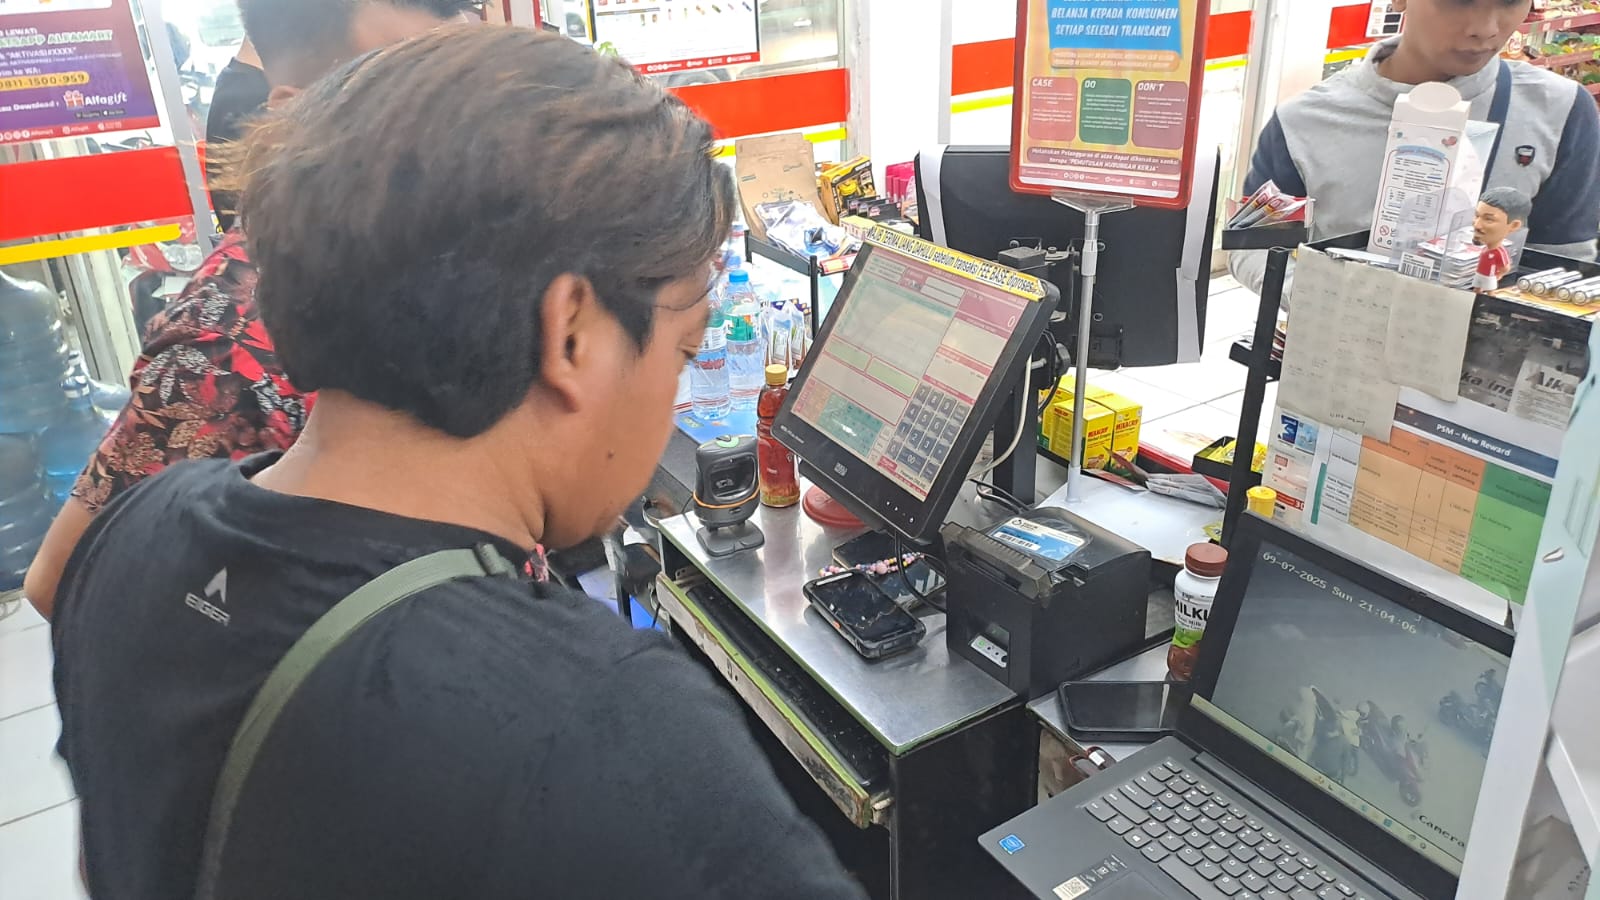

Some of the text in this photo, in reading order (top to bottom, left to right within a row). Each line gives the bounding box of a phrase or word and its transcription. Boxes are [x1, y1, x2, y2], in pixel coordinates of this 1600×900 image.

[1051, 7, 1179, 20] BELANJA KEPADA KONSUMEN
[1055, 24, 1172, 38] SETIAP SELESAI TRANSAKSI
[1032, 78, 1054, 88] CASE
[1084, 79, 1097, 89] DO
[1137, 82, 1165, 92] DON'T
[85, 91, 128, 106] Alfagift
[933, 249, 955, 266] sebelum
[978, 261, 991, 278] FEE
[991, 264, 1009, 284] BASE
[1436, 423, 1455, 436] PSM
[1461, 432, 1479, 445] New
[1480, 440, 1512, 457] Reward
[1262, 551, 1417, 635] 09-07-2025 Sun 21:04:06
[185, 592, 231, 626] EIGER
[1418, 814, 1466, 848] Camera
